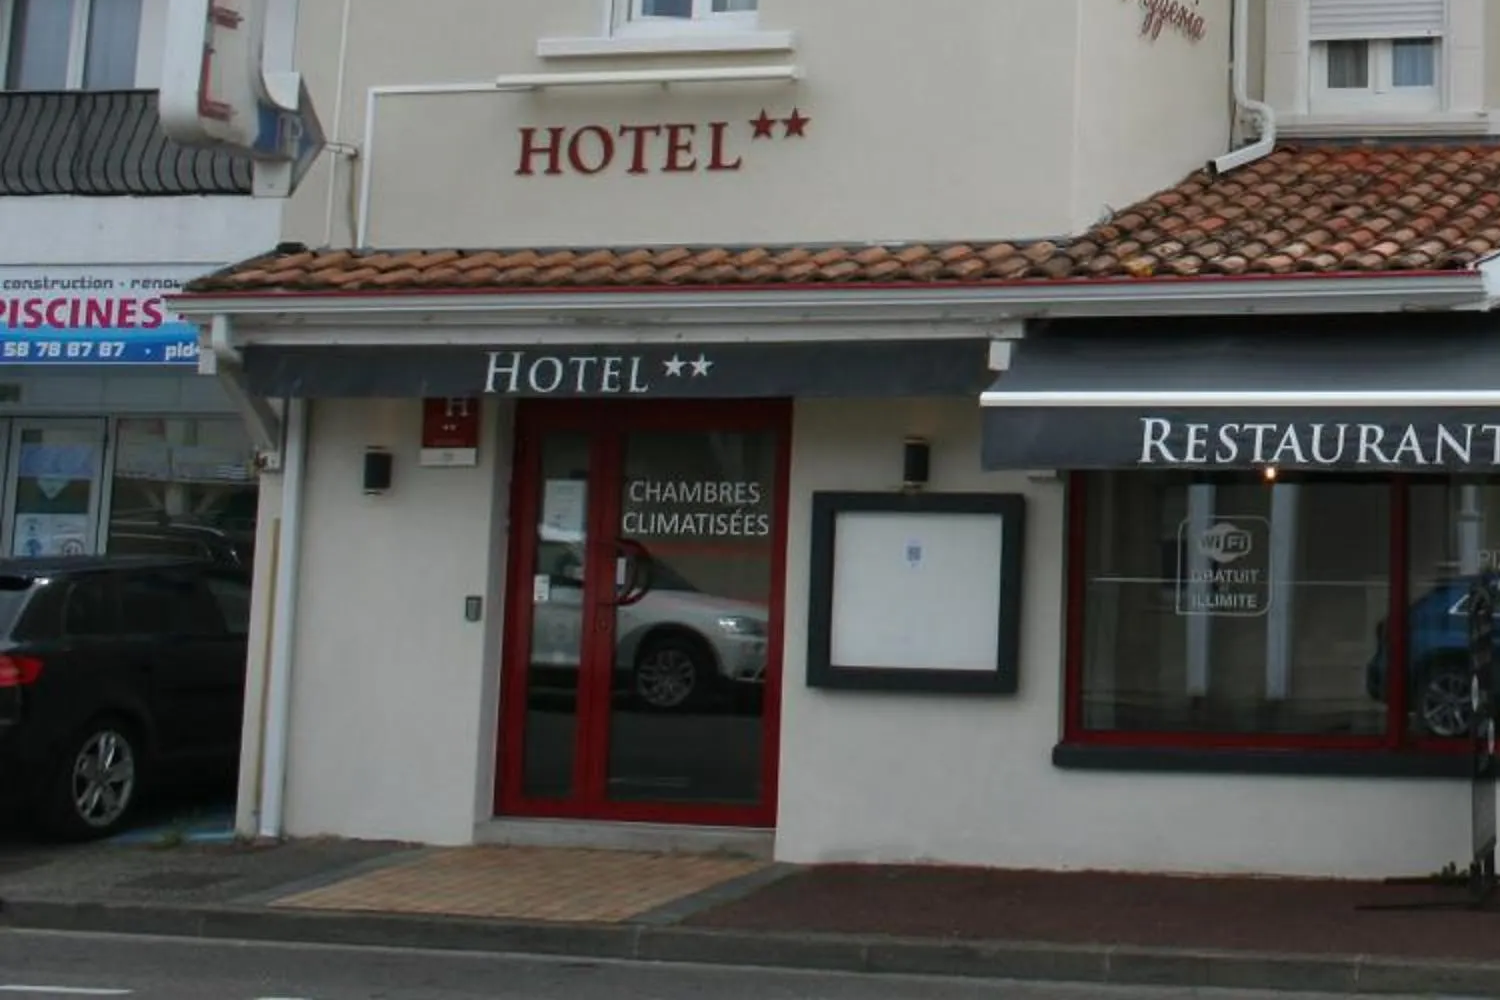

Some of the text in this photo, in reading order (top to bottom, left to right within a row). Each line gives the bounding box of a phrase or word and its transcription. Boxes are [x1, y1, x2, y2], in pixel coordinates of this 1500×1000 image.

[514, 121, 743, 176] HOTEL
[3, 277, 114, 290] construction
[483, 351, 650, 395] HOTEL
[628, 479, 762, 504] CHAMBRES
[621, 508, 770, 537] CLIMATISÉES
